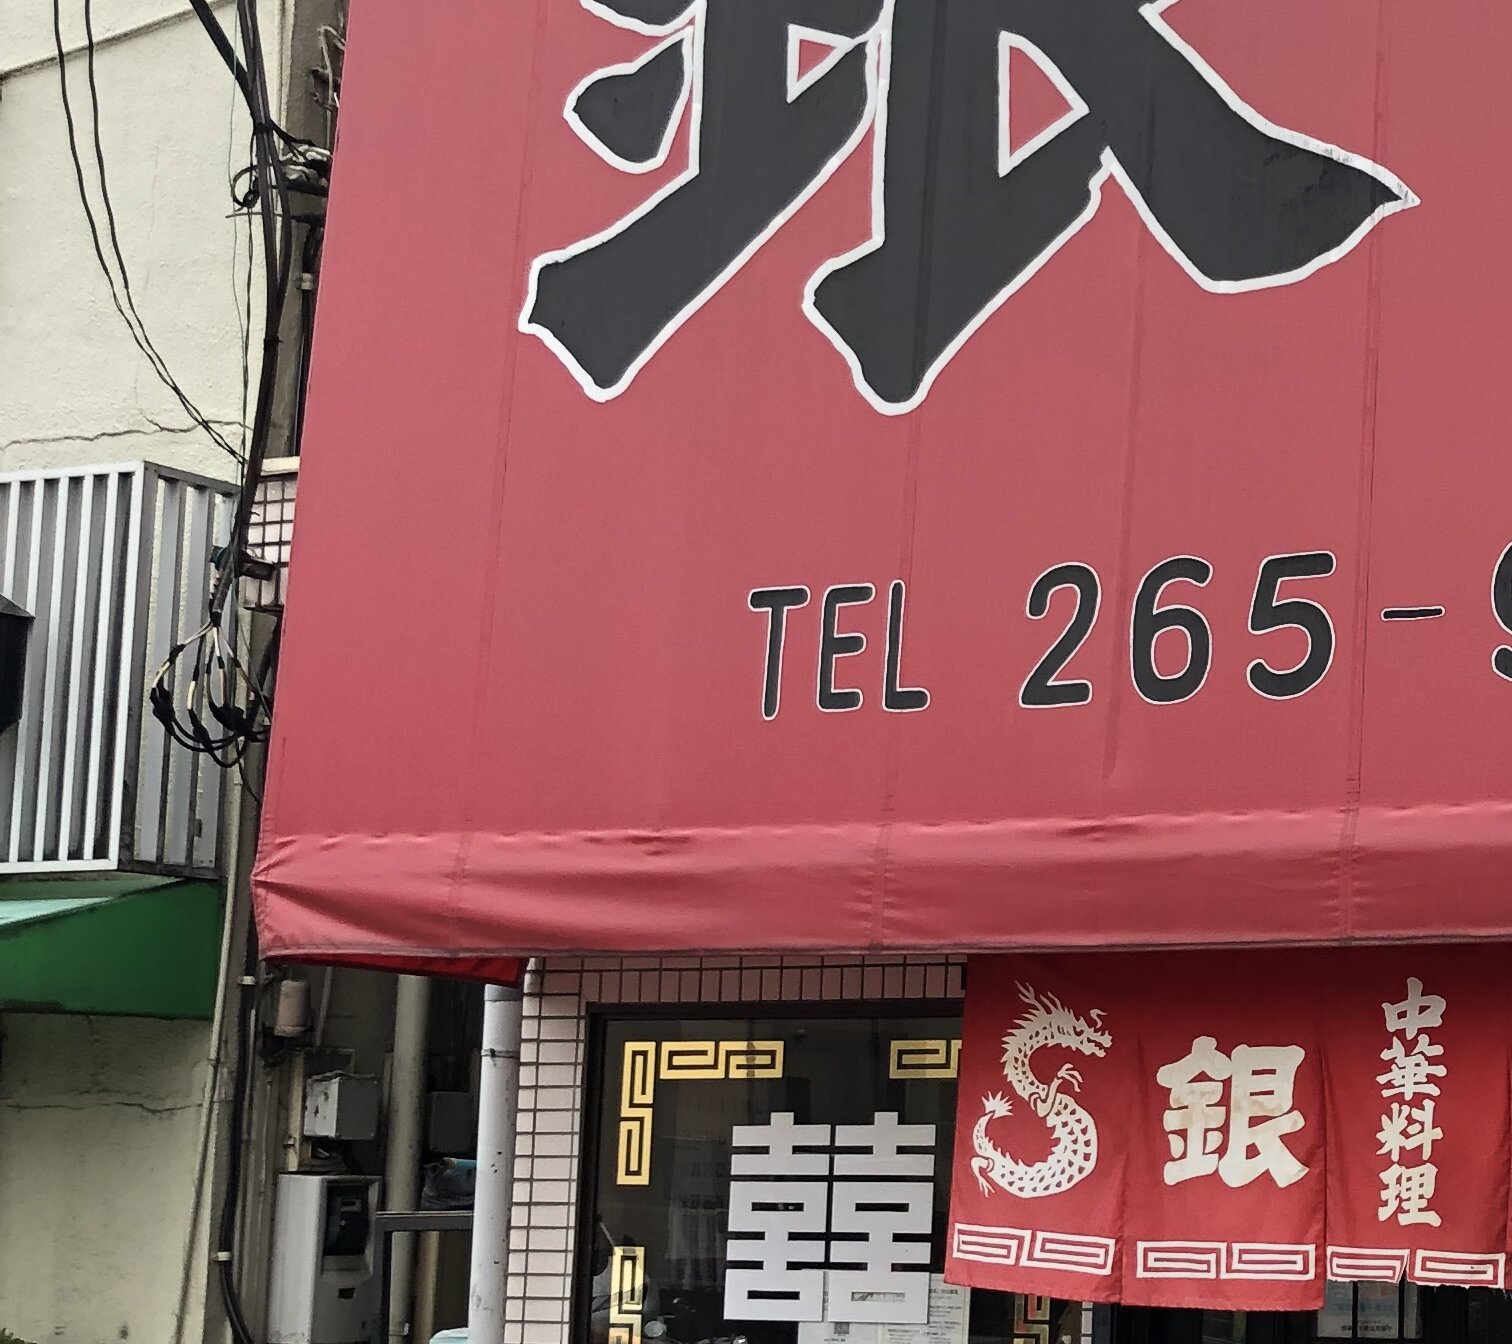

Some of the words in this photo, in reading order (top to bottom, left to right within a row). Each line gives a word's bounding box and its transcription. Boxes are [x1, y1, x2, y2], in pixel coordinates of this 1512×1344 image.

[747, 579, 931, 722] TEL
[1156, 1034, 1309, 1188] 銀
[1375, 976, 1447, 1228] 中華料理
